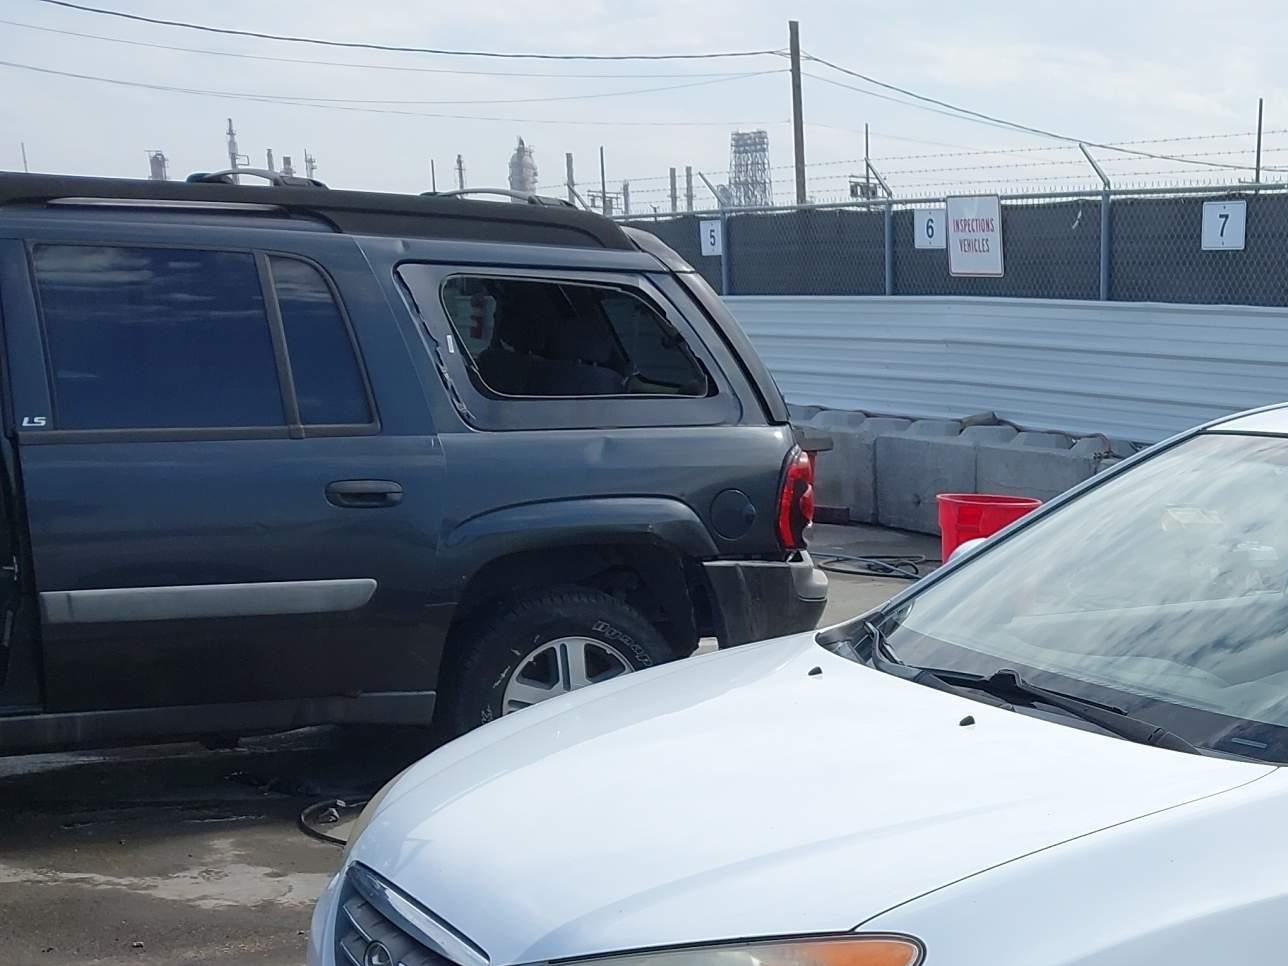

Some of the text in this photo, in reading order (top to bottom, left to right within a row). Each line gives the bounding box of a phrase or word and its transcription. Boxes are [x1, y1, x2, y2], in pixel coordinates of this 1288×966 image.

[926, 218, 935, 239] 6
[952, 217, 995, 233] INSPECTIONS
[1218, 213, 1229, 237] 7
[709, 229, 716, 247] 5
[959, 238, 990, 253] VEHICLES
[22, 416, 47, 427] LS
